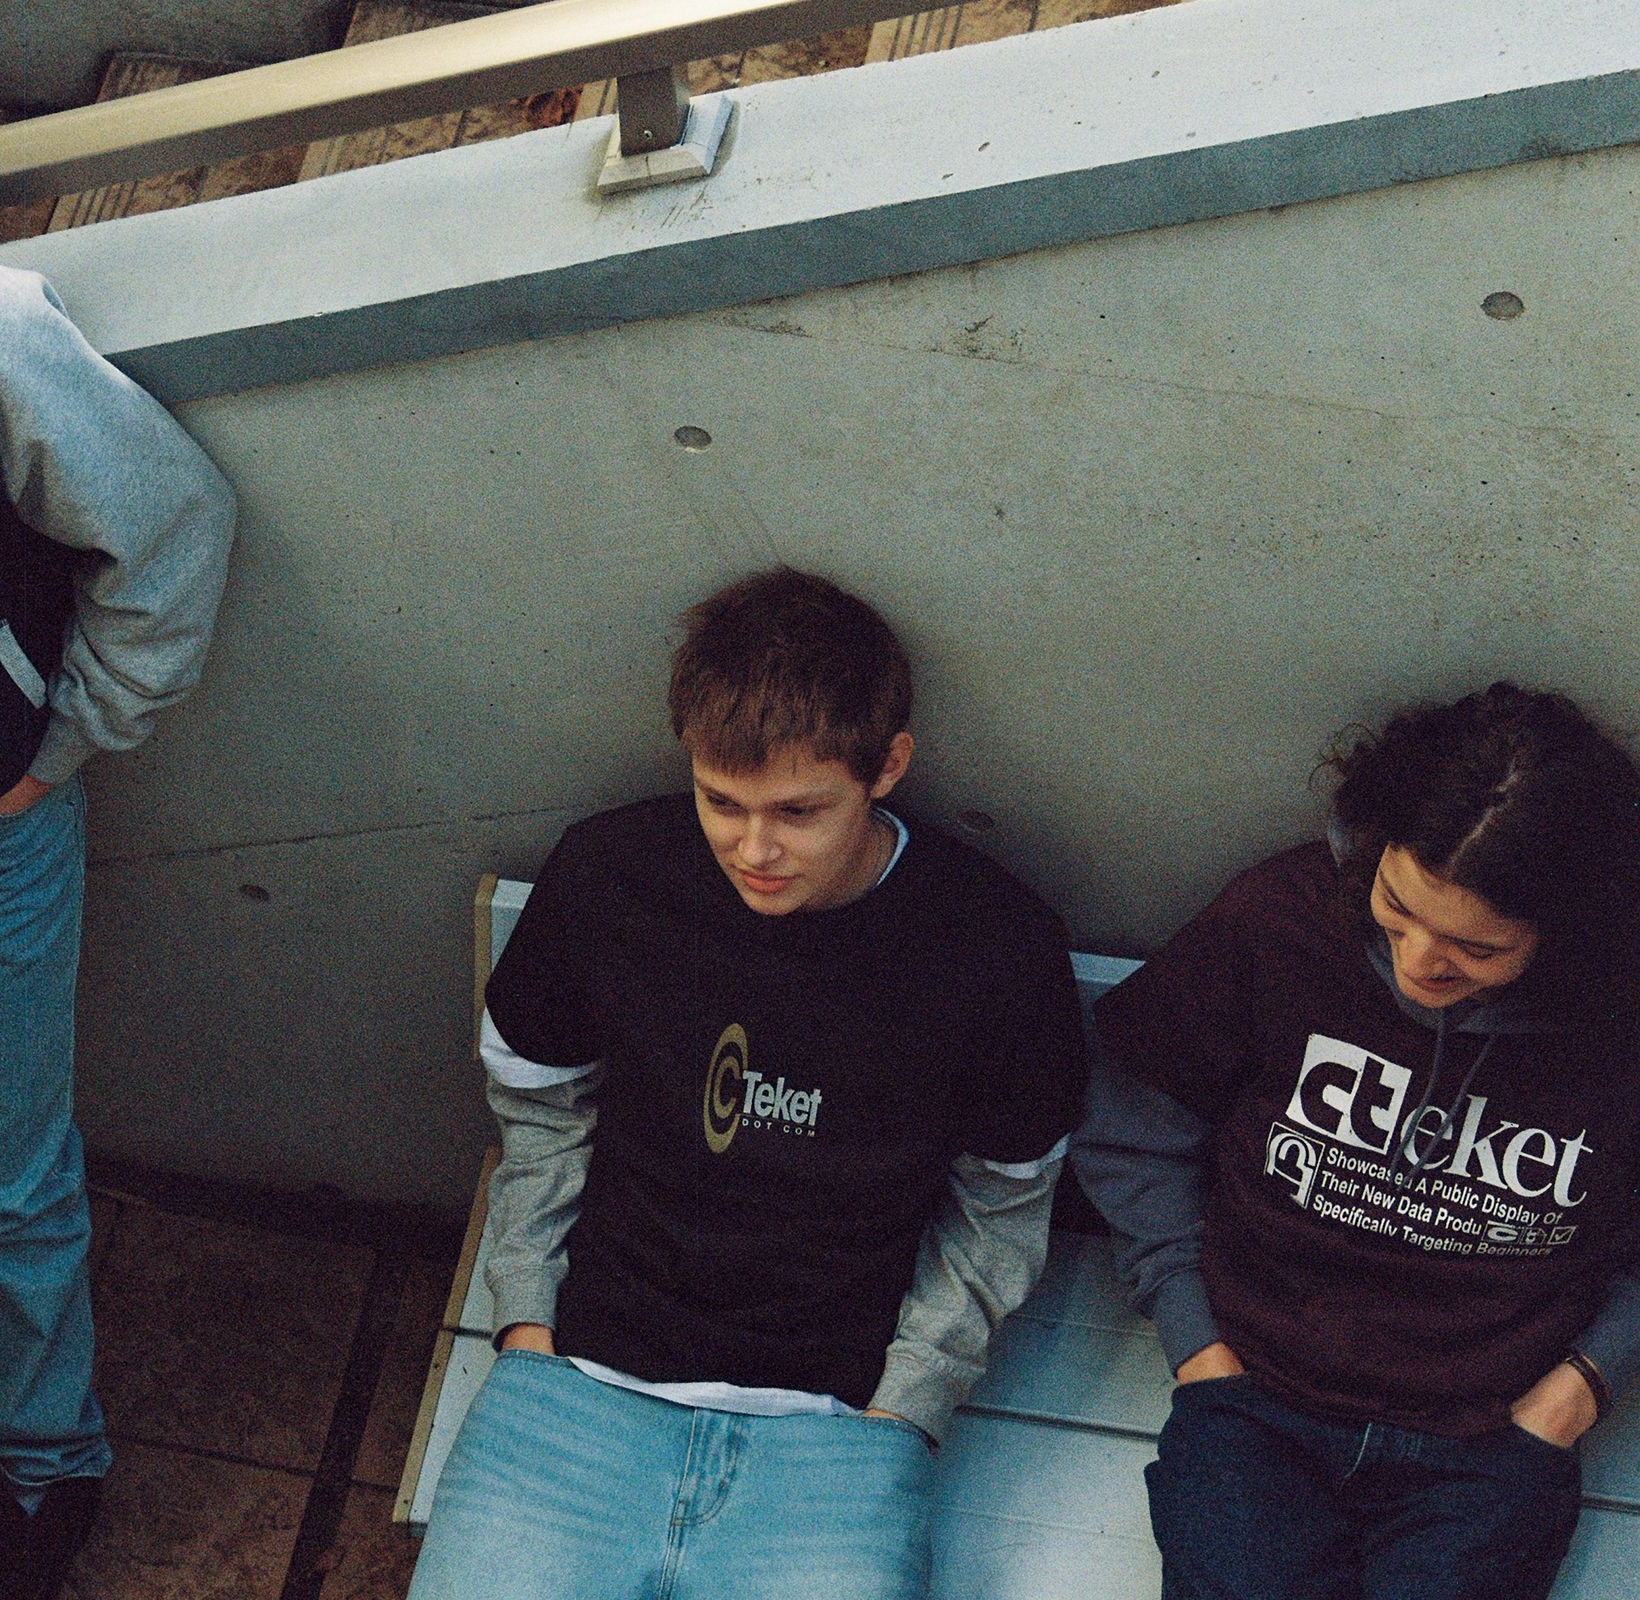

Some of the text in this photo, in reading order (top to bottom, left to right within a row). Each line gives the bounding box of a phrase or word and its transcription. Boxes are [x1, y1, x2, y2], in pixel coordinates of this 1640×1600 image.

[741, 1117, 816, 1138] DOT COM
[1312, 1194, 1398, 1237] Specifically
[1402, 1225, 1473, 1255] Targeting
[1321, 1170, 1360, 1197] Their
[1361, 1183, 1396, 1210] New
[1397, 1195, 1433, 1223] Data
[1434, 1206, 1483, 1236] Produ
[1415, 1177, 1427, 1195] A
[1430, 1179, 1480, 1210] Public
[1482, 1193, 1540, 1227] Display
[1542, 1211, 1564, 1225] Of
